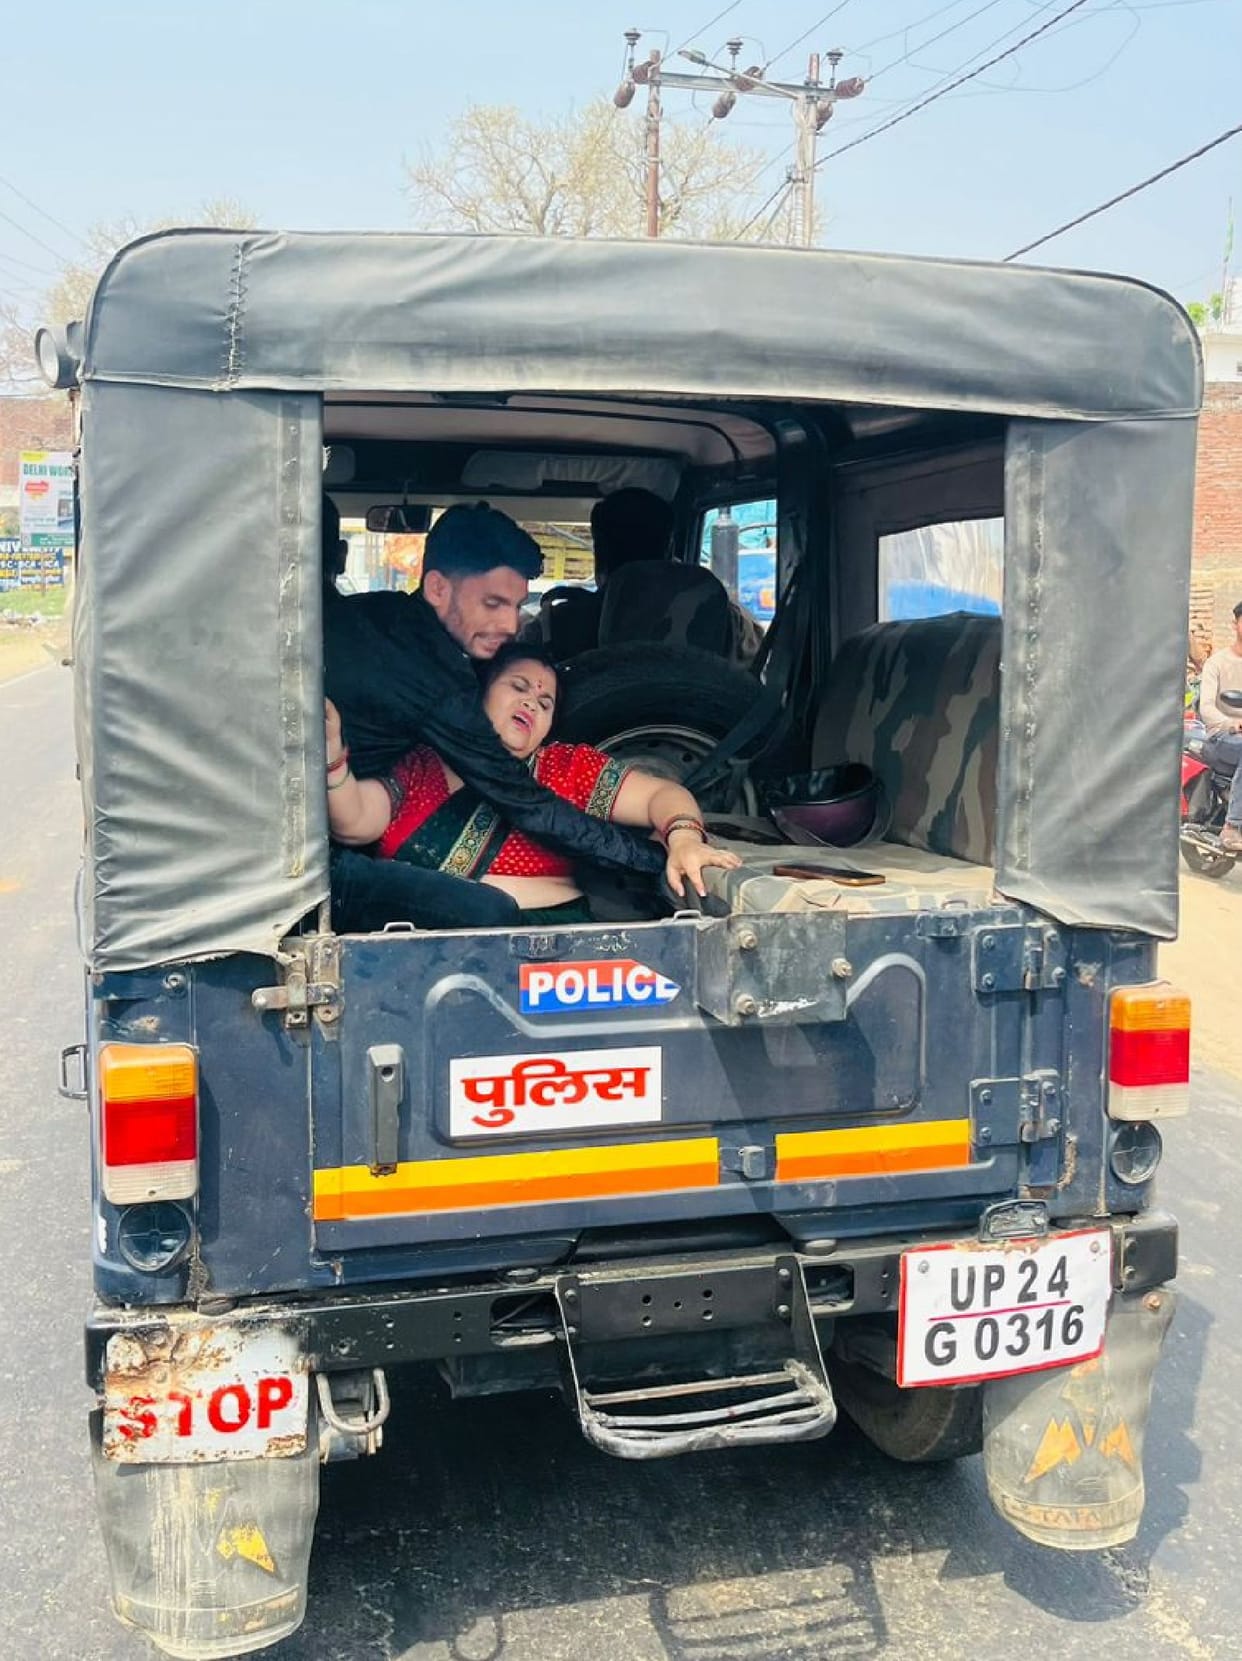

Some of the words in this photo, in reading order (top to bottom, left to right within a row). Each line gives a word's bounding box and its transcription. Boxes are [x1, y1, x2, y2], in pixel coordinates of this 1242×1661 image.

[528, 965, 681, 1005] POLICE
[460, 1058, 651, 1128] पुलिस
[924, 1322, 958, 1367] G
[974, 1305, 1085, 1361] 0316
[118, 1377, 293, 1439] STOP
